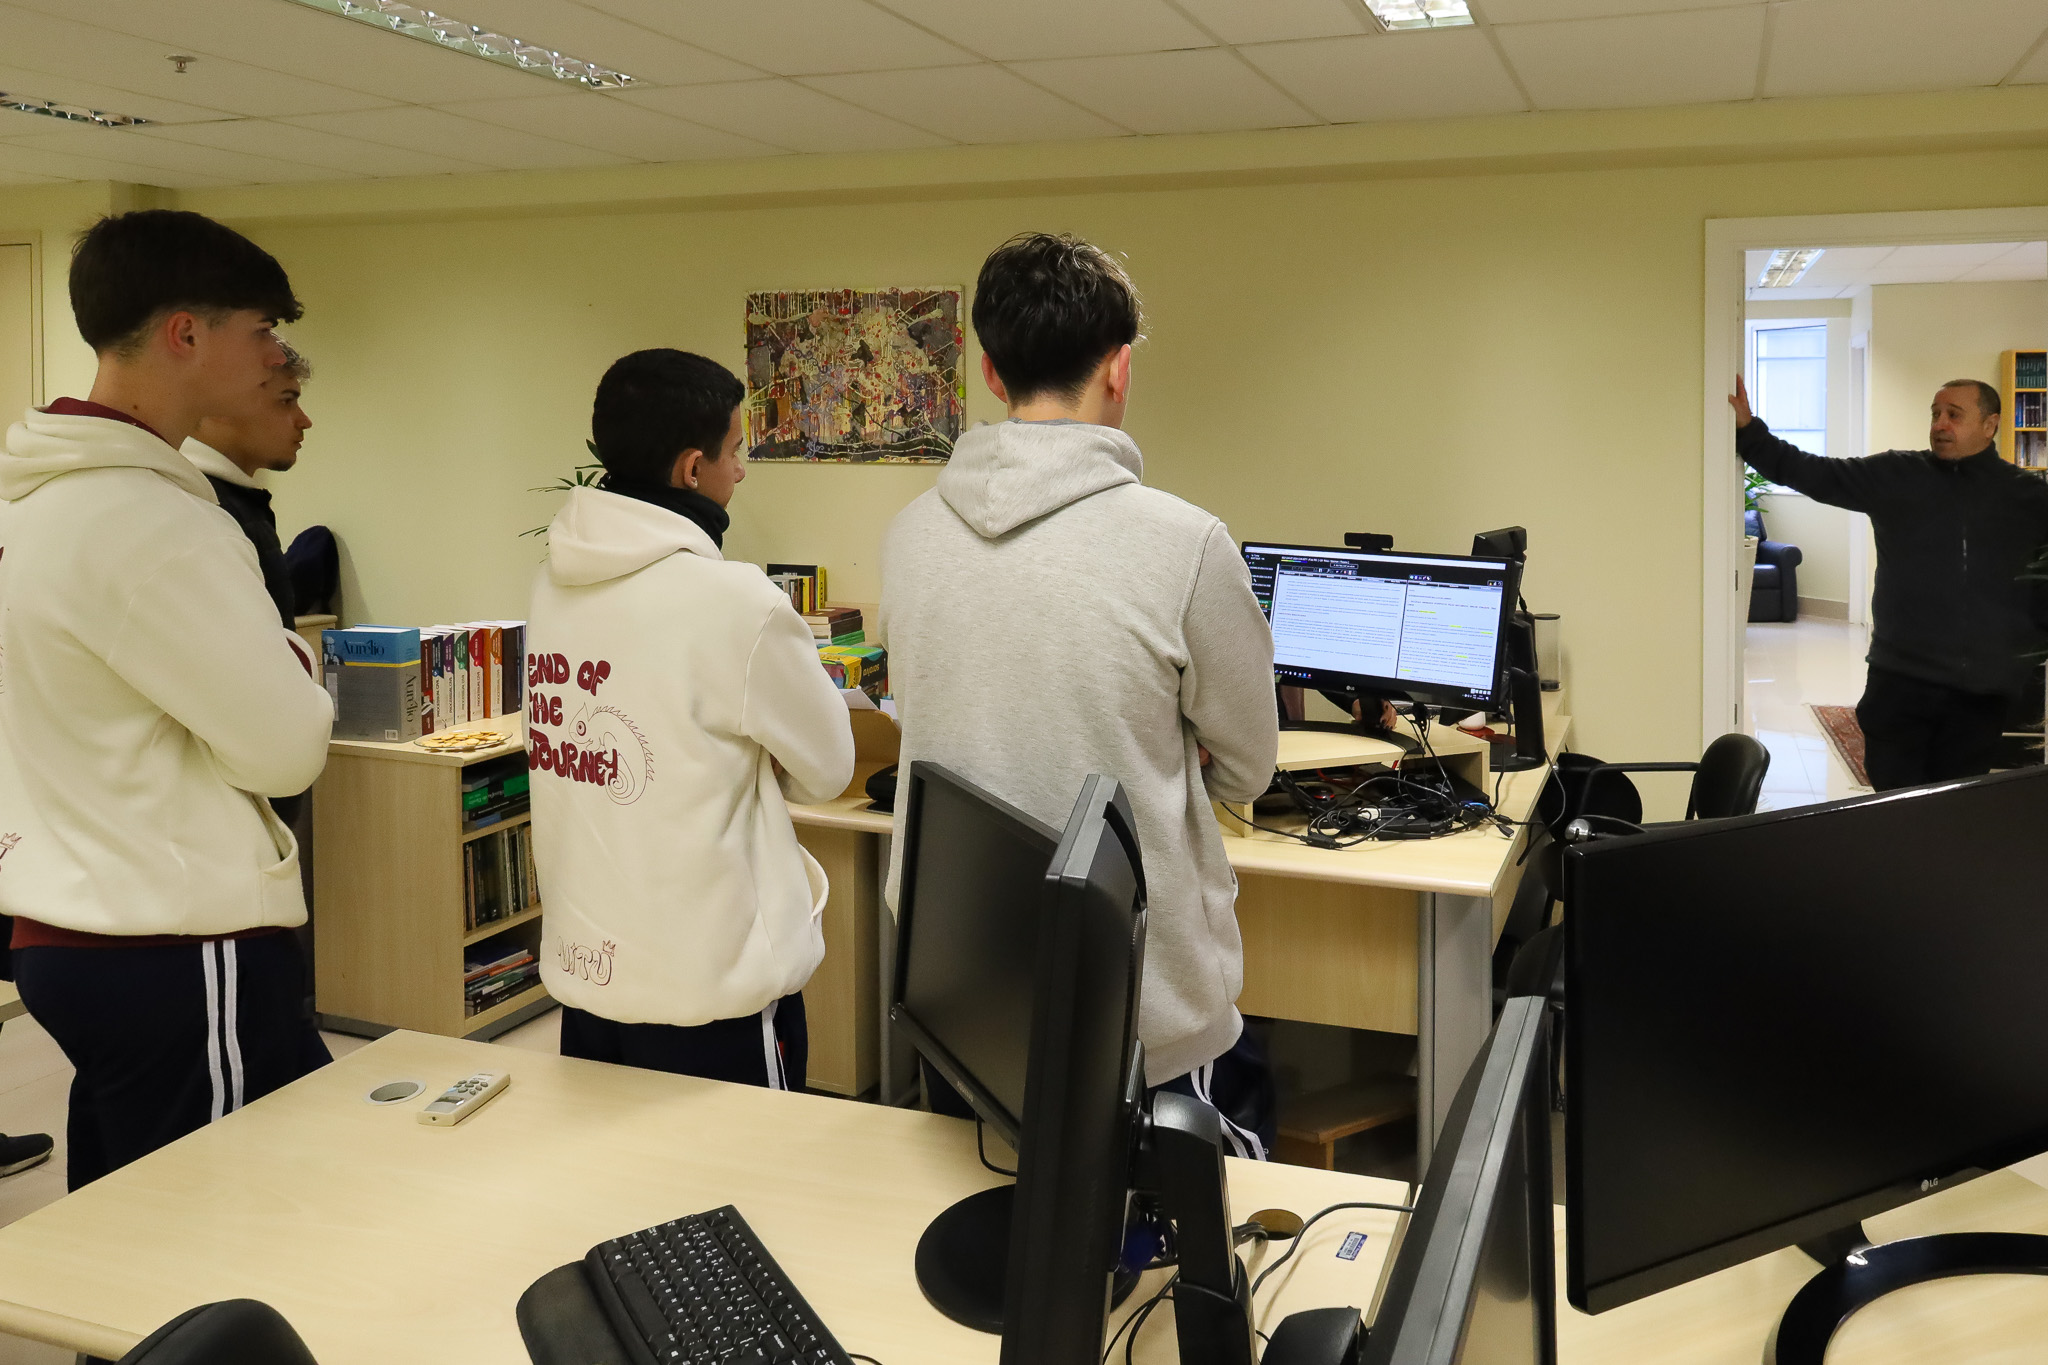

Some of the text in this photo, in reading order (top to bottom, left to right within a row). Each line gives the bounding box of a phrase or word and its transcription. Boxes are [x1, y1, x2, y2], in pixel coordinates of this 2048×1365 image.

[528, 653, 611, 696] END OF
[529, 727, 617, 786] JOURNEY
[1929, 1177, 1939, 1187] LG
